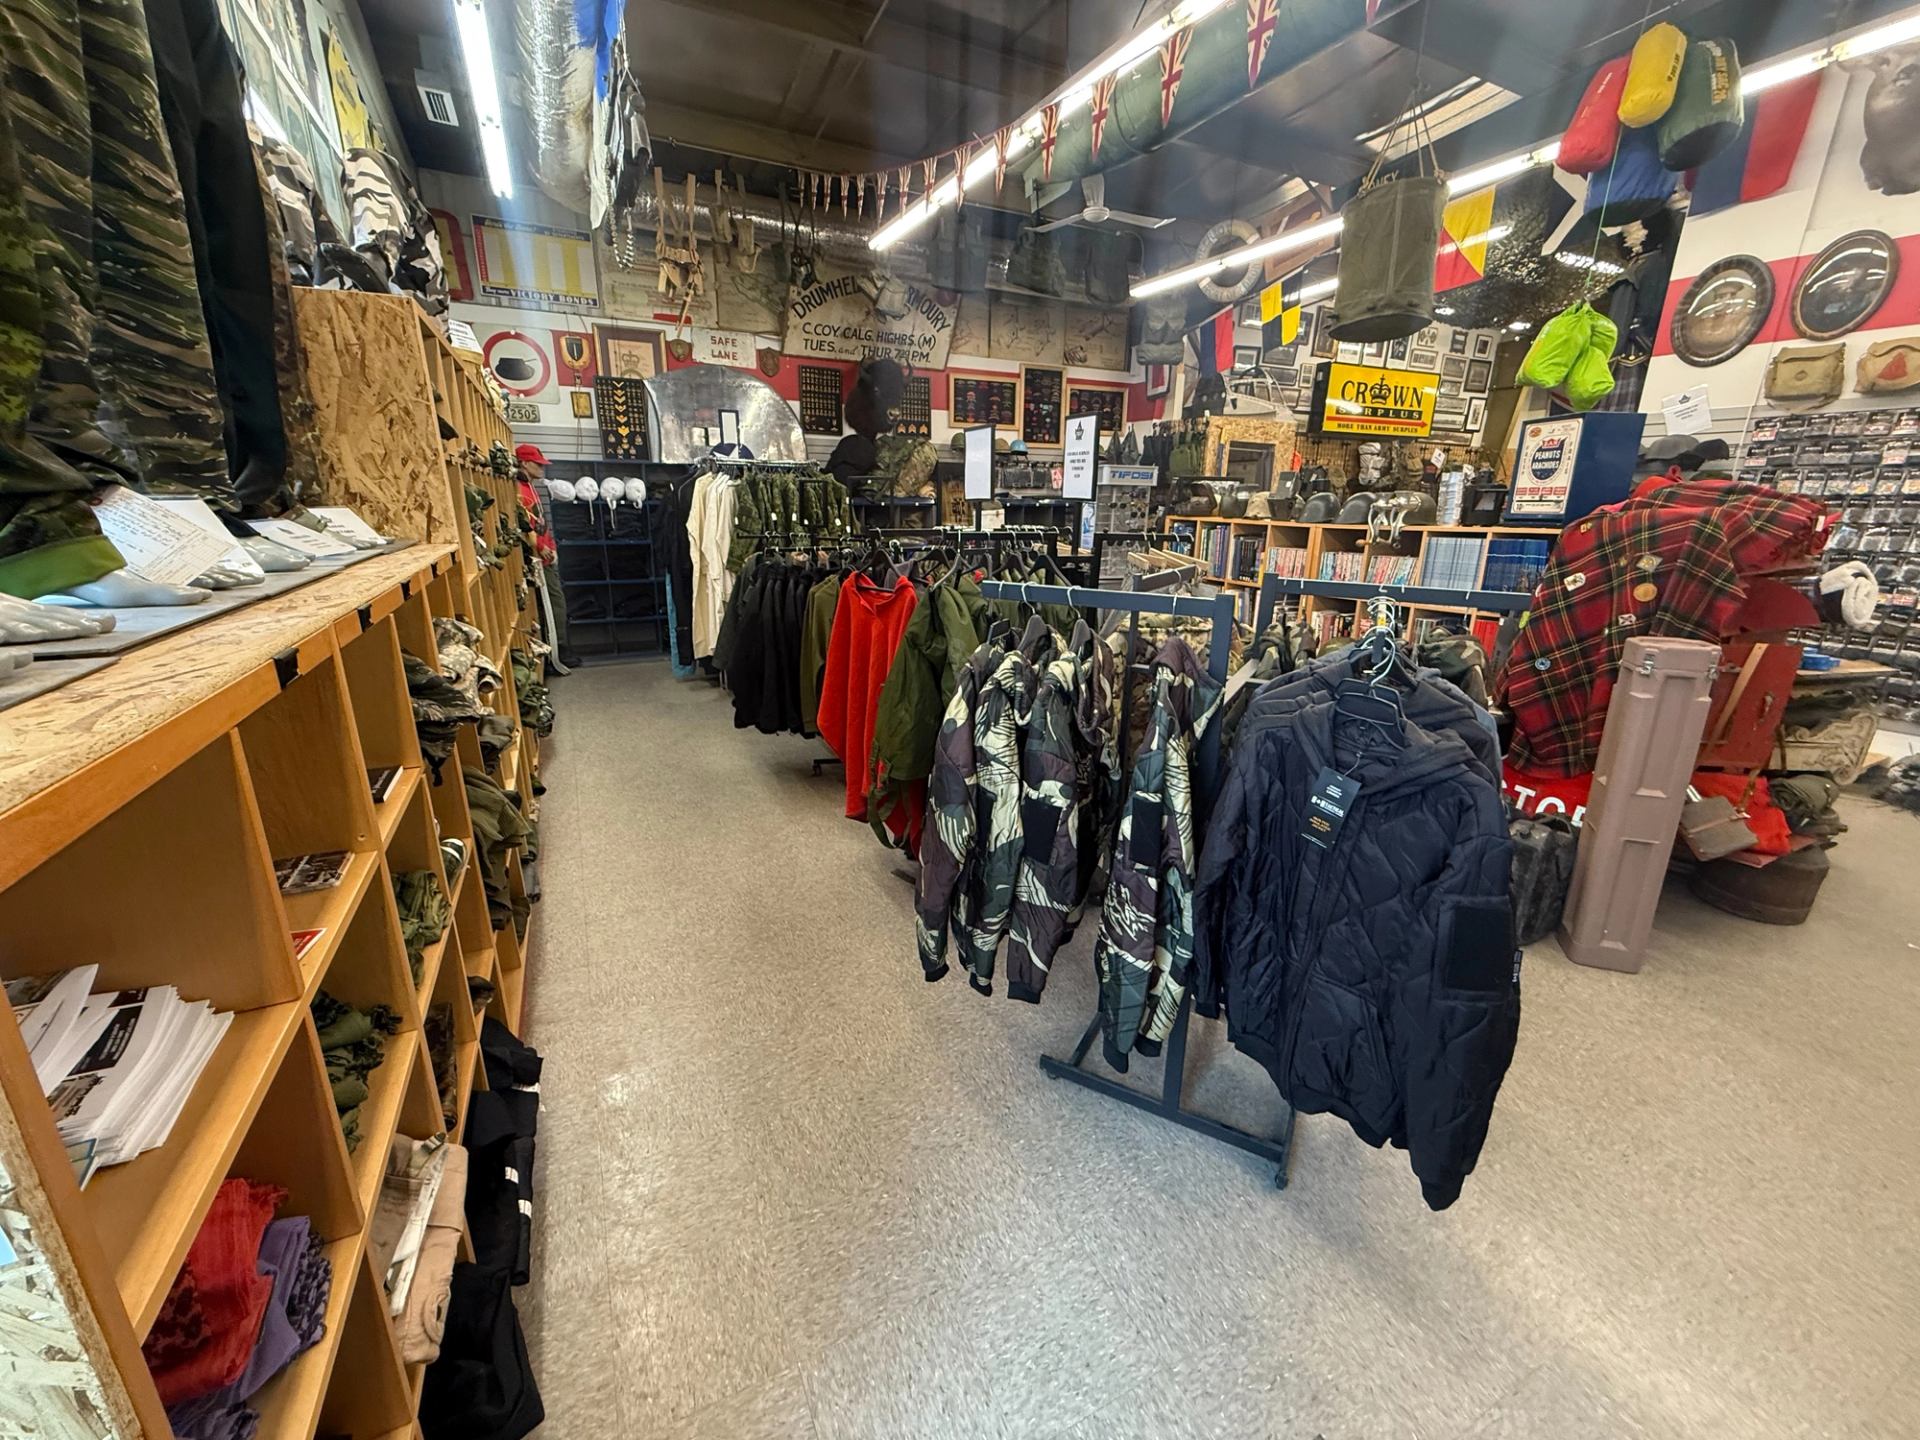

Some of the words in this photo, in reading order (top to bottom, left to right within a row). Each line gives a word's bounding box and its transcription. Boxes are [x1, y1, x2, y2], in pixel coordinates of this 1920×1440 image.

[511, 289, 554, 300] VICTORY
[559, 296, 594, 304] BONDS
[711, 336, 737, 347] SAFE
[843, 327, 874, 342] CALG.
[918, 333, 937, 351] (M)
[803, 338, 837, 353] TUES.
[838, 346, 858, 355] and
[712, 350, 737, 360] LANE
[1338, 407, 1420, 419] SRPLUS
[1534, 450, 1561, 460] PEANUTS
[1110, 470, 1154, 480] TIFOSI
